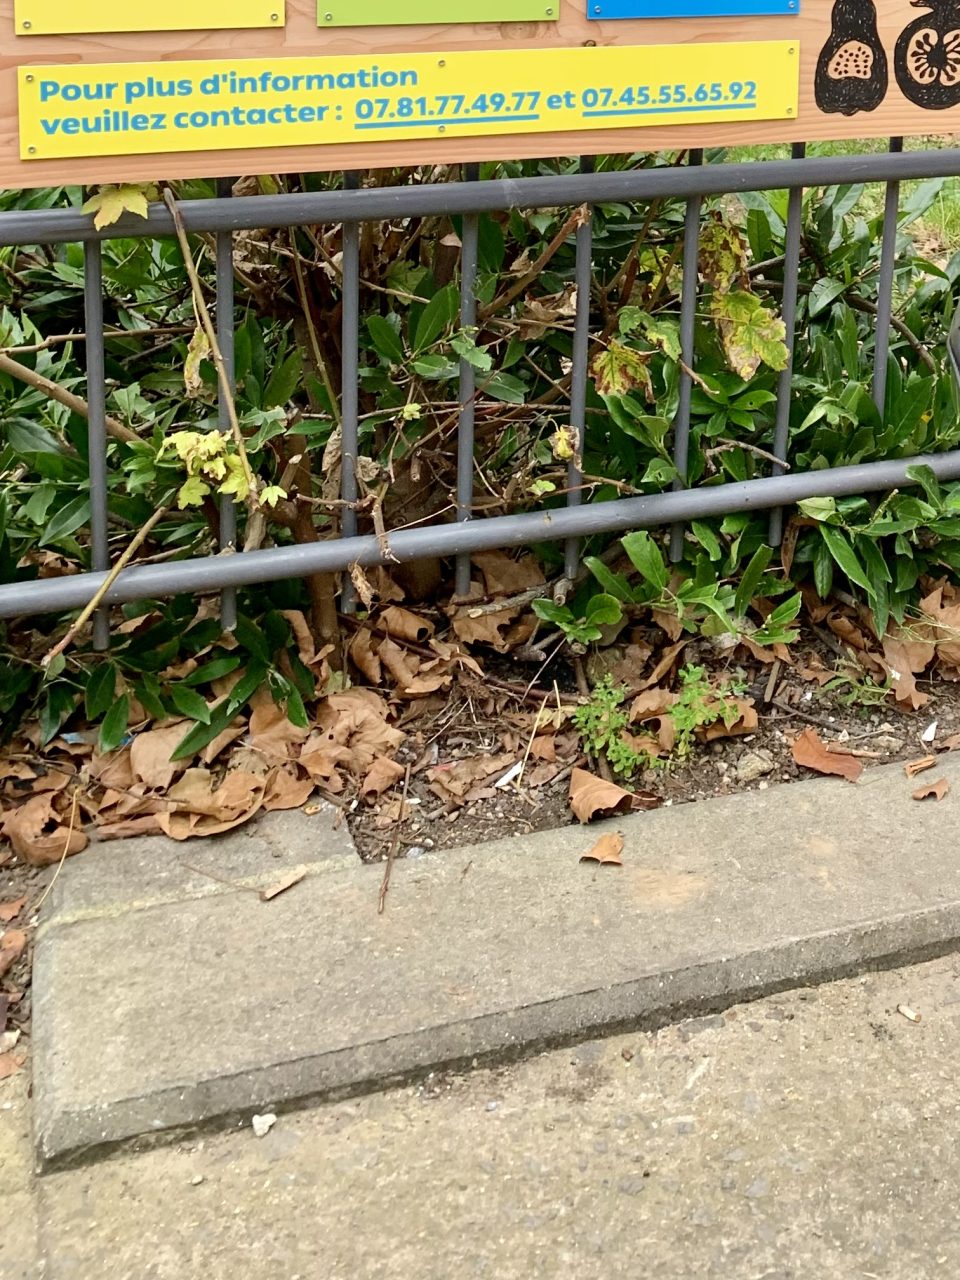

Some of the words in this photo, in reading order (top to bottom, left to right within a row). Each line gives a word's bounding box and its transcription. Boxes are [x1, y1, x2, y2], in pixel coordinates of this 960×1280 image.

[39, 81, 118, 102] Pour
[124, 76, 192, 105] plus
[200, 67, 418, 96] d'information
[40, 110, 166, 136] veuillez
[355, 91, 541, 120] 07.81.77.49.77
[546, 91, 575, 110] et
[582, 81, 757, 109] 07.45.55.65.92
